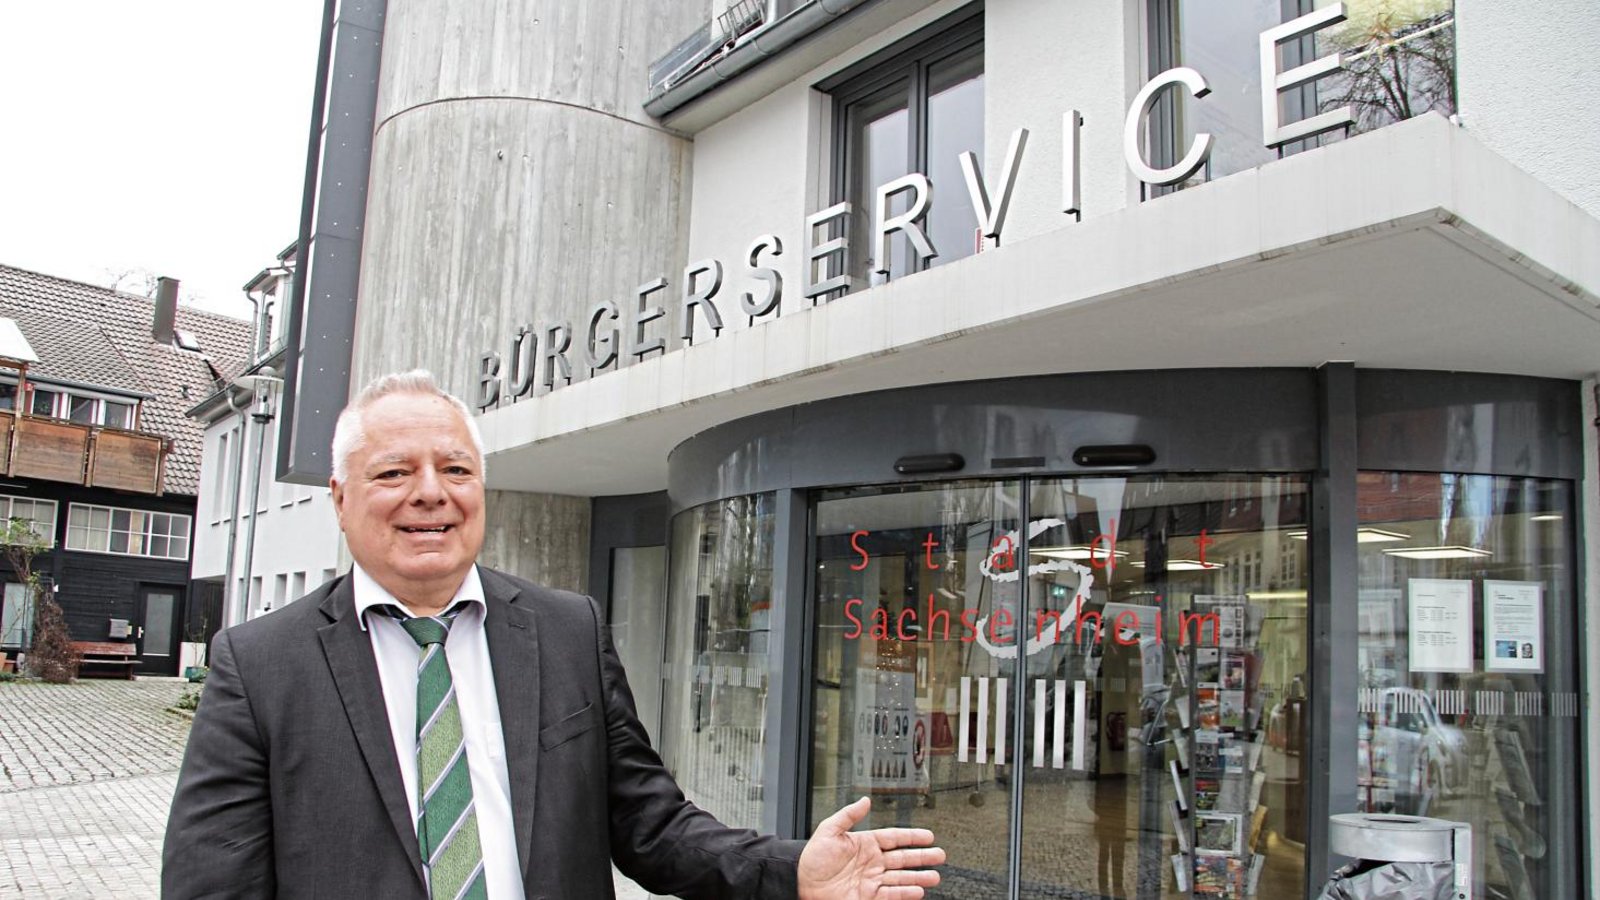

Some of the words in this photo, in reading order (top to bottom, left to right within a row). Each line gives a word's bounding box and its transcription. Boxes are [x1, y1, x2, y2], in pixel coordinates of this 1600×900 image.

[476, 1, 1355, 409] BÜRGERSERVICE
[850, 517, 1214, 571] Stadt
[843, 593, 1221, 647] Sachsenheim
